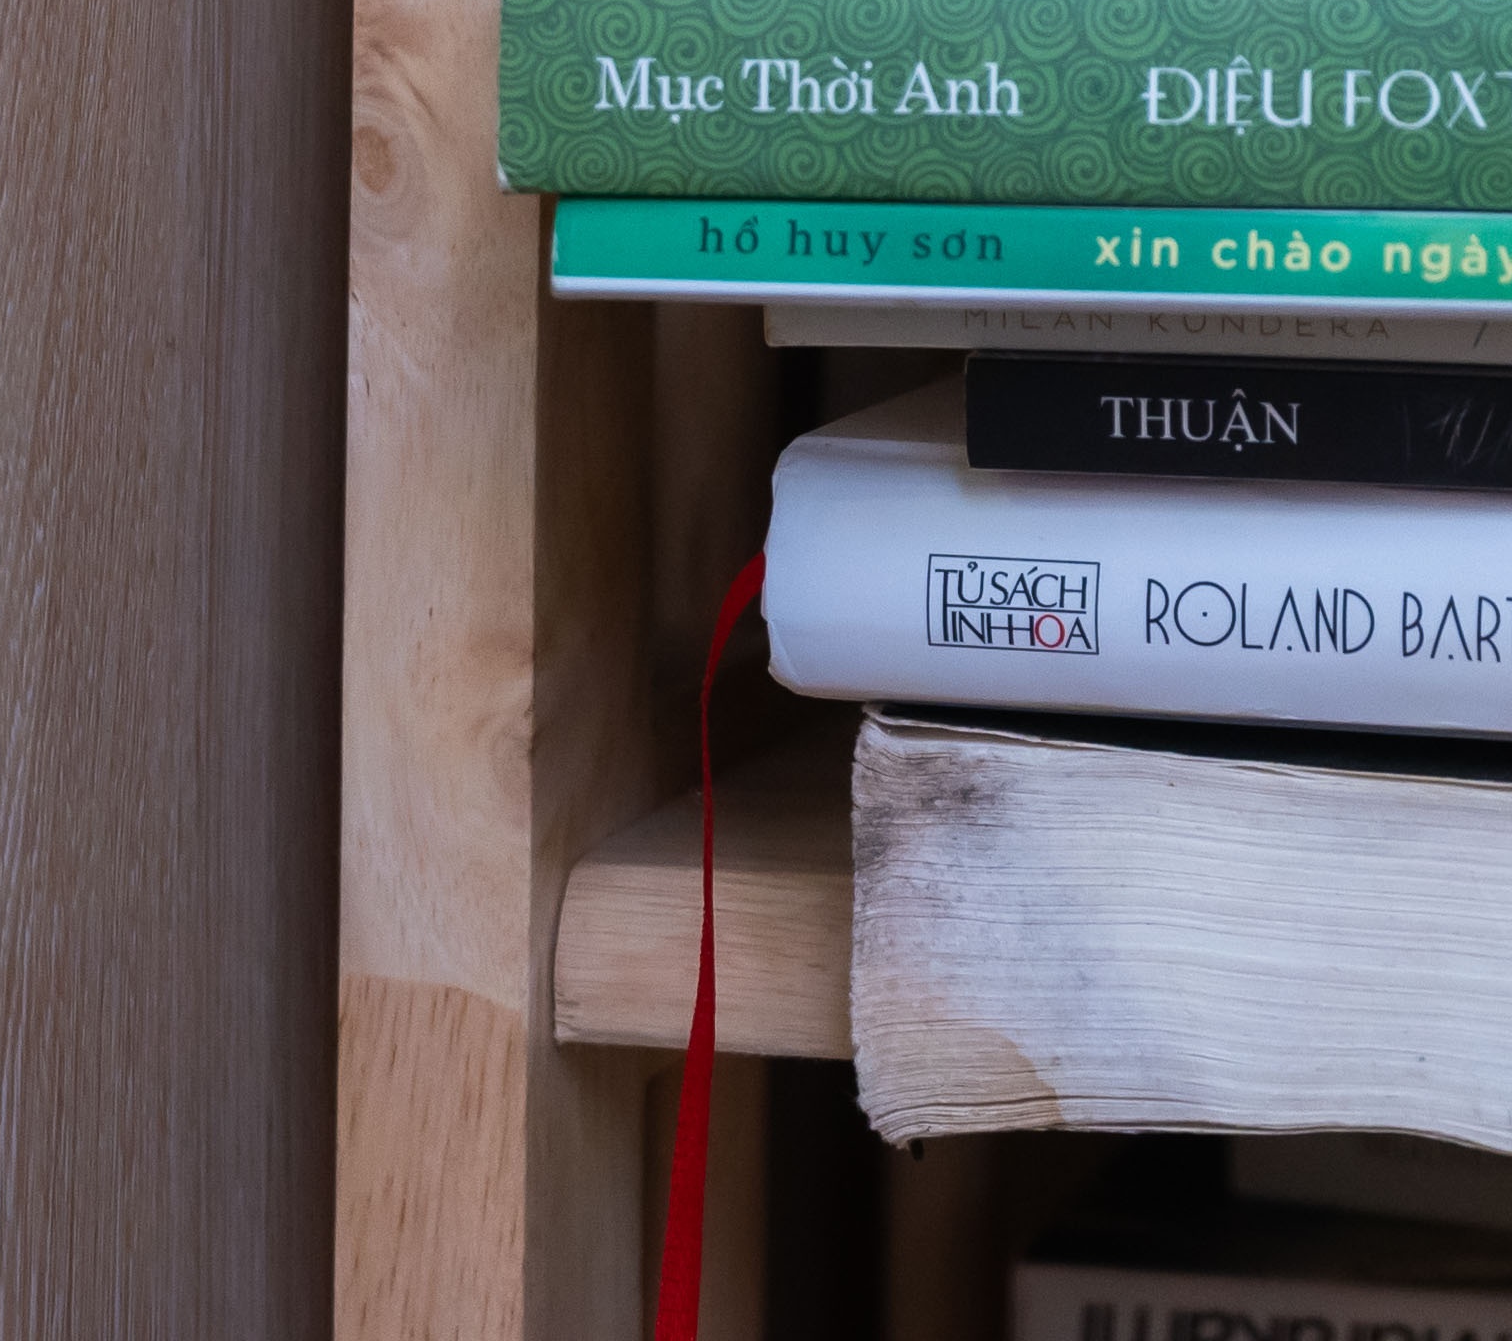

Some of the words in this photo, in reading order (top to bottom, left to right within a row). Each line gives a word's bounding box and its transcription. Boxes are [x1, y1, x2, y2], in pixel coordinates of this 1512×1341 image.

[594, 57, 724, 126] Mục
[743, 54, 877, 117] Thời
[893, 60, 1024, 118] Anh
[1140, 54, 1313, 135] ĐIỆU
[787, 216, 888, 266] huy
[913, 226, 1004, 261] sơn
[1094, 227, 1180, 268] xin
[1211, 227, 1352, 274] chào
[963, 308, 1114, 330] MILAN
[1148, 314, 1392, 339] KUNDERA
[1100, 388, 1300, 452] THUẬN
[989, 566, 1087, 609] SÁCH
[1144, 578, 1377, 656] ROLAND
